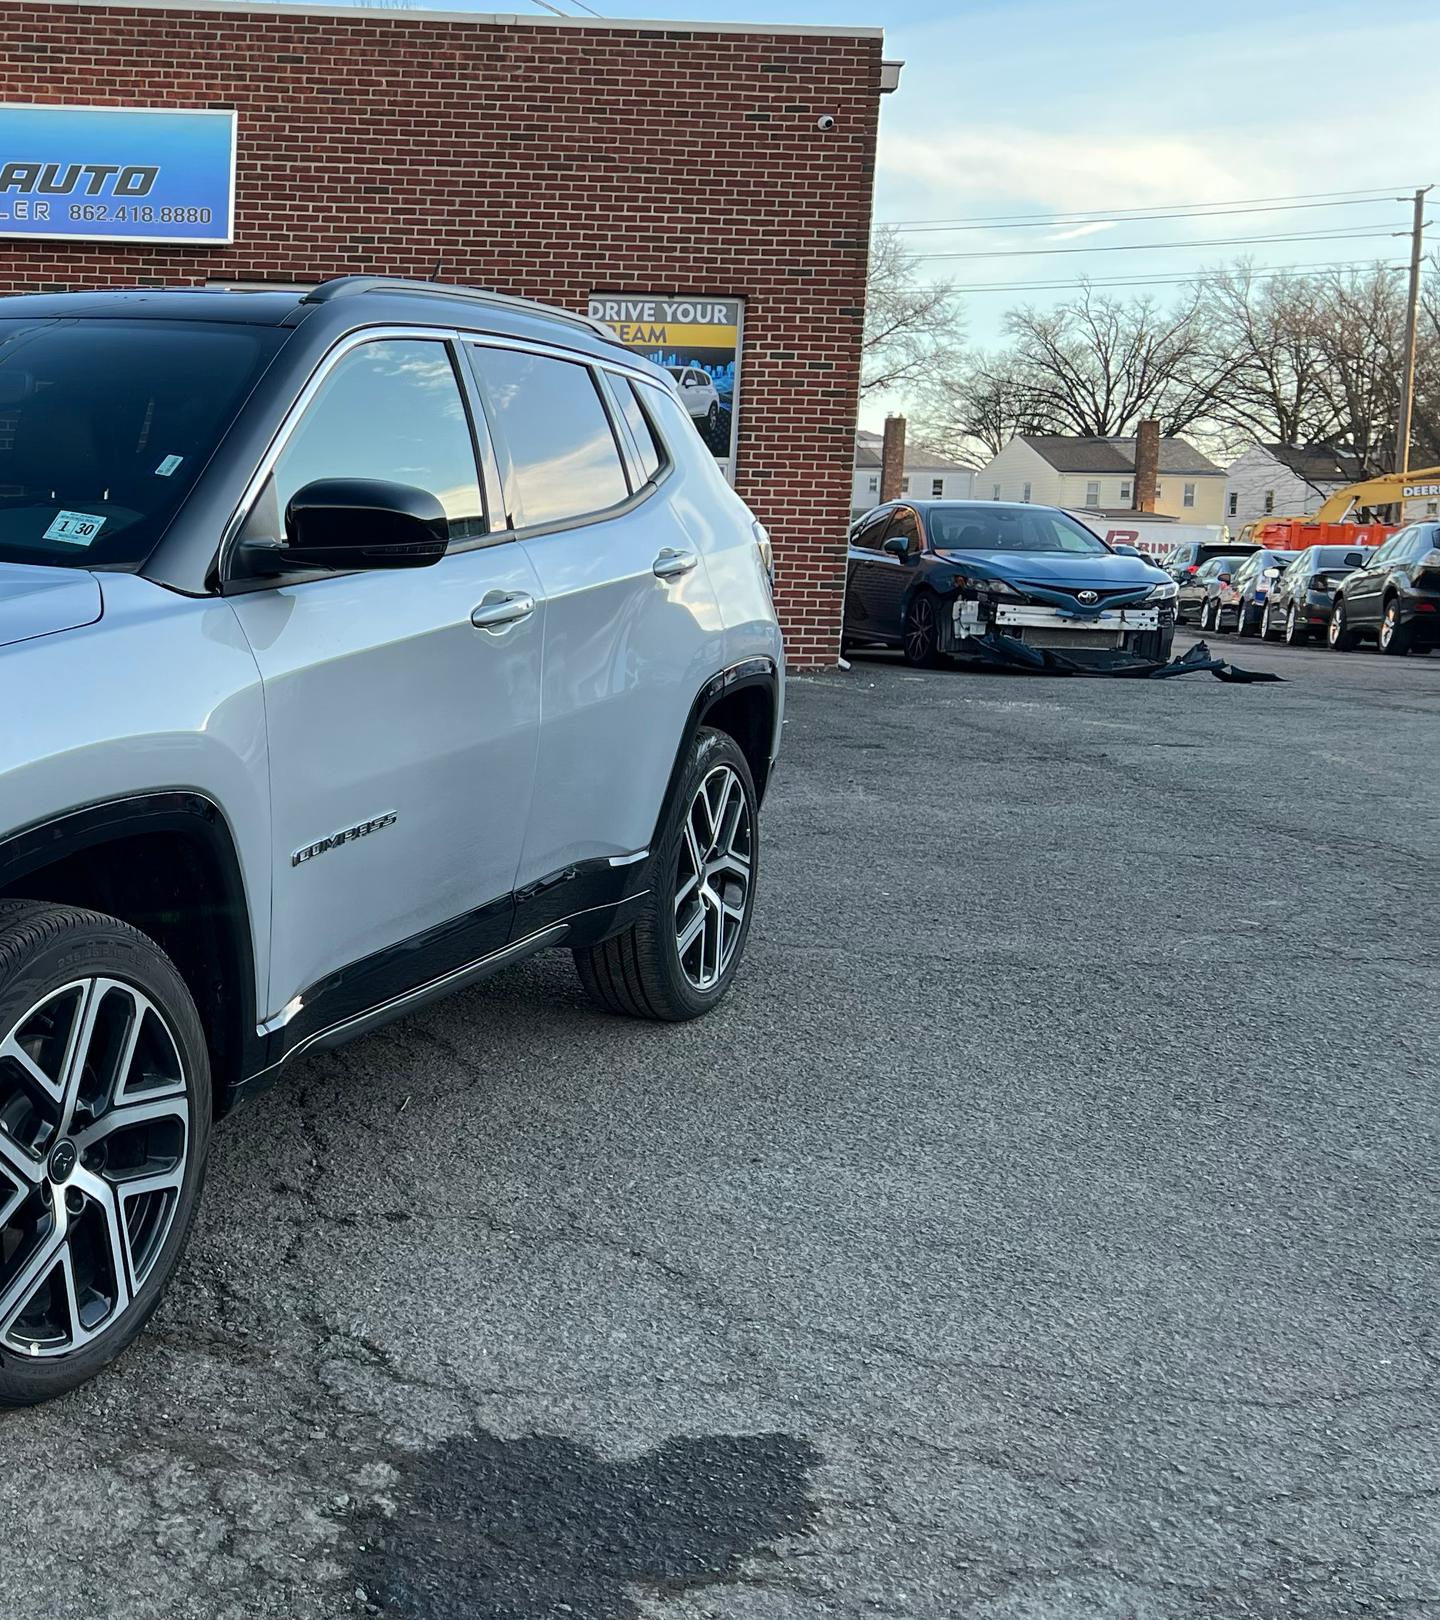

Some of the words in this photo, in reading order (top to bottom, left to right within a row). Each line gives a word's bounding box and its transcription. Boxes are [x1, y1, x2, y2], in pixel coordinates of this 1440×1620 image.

[68, 203, 212, 226] 862.418.8880
[588, 301, 656, 321] DRIVE
[662, 303, 728, 324] YOUR
[1403, 486, 1440, 497] DEER
[58, 521, 69, 532] 1
[75, 523, 94, 535] 30
